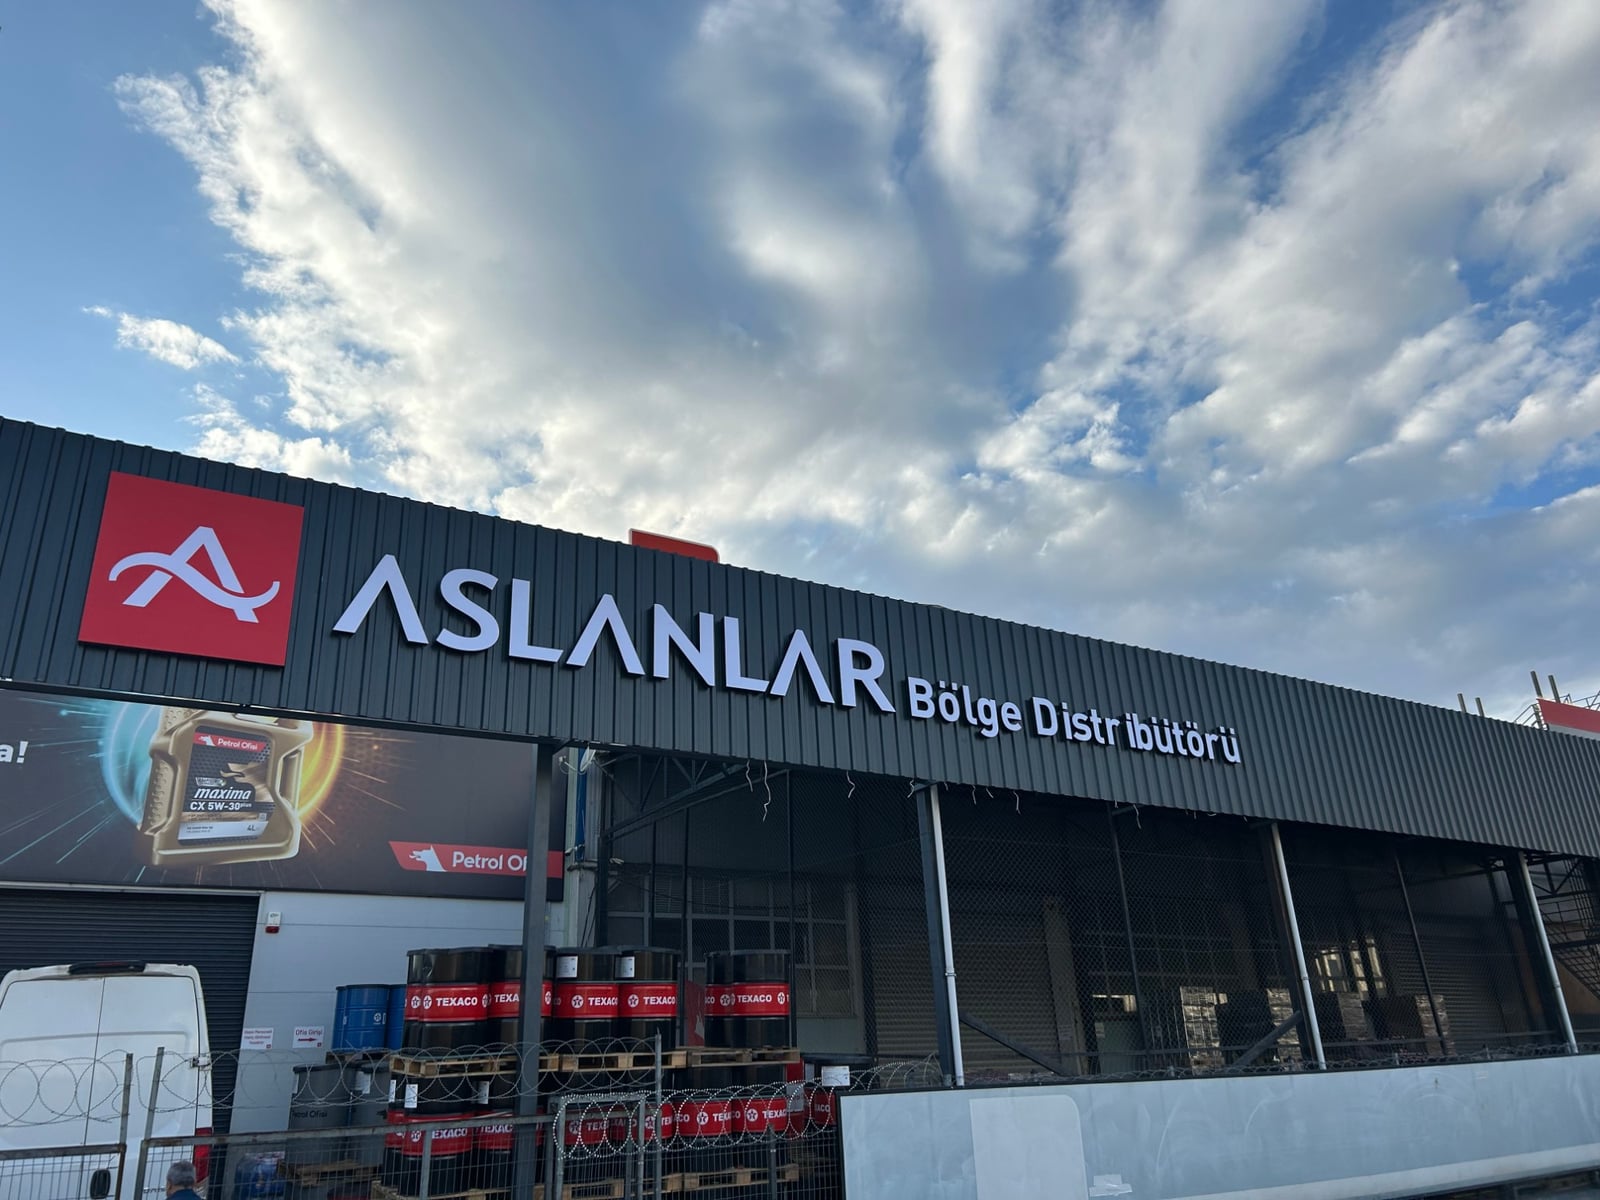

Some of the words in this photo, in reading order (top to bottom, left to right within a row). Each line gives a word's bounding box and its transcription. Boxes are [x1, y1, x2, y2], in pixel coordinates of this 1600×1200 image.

[333, 554, 896, 713] ASLANLAR
[907, 676, 1022, 738] Bölge
[1032, 696, 1241, 764] Distribütörü
[217, 737, 240, 748] Petrol
[241, 741, 258, 750] Ofisi
[193, 786, 252, 800] maxima
[190, 801, 205, 811] CX
[452, 850, 503, 870] Petrol
[436, 996, 478, 1007] TEXACO
[494, 993, 520, 1003] TEXA
[643, 996, 676, 1005] TEXACO
[737, 994, 773, 1004] TEXACO
